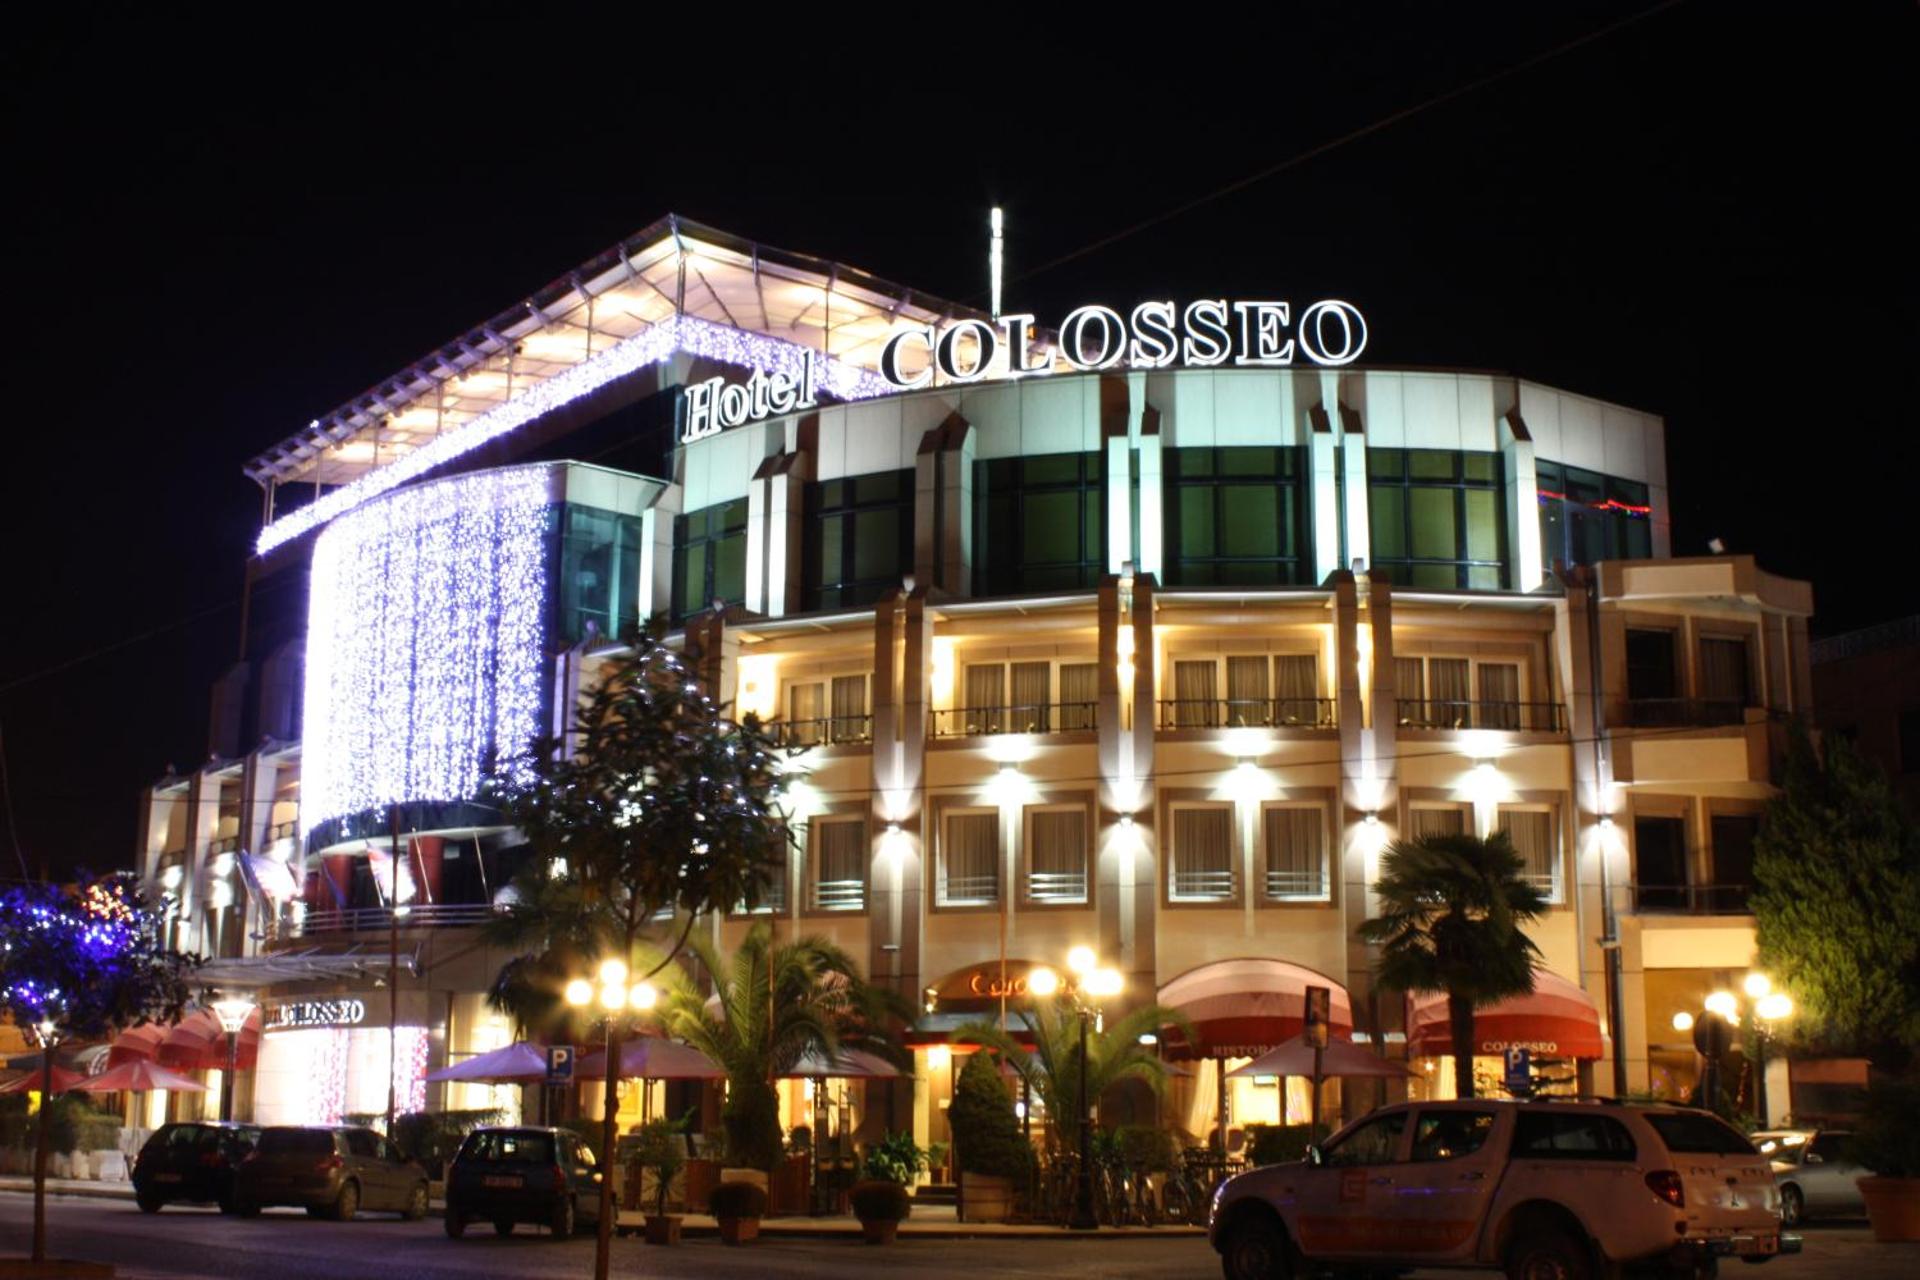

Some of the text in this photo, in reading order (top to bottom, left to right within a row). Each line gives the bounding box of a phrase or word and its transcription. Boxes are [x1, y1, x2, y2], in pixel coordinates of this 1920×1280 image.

[681, 299, 1368, 444] Hotel COLOSSEO
[552, 1049, 568, 1070] P
[1508, 1051, 1523, 1070] P
